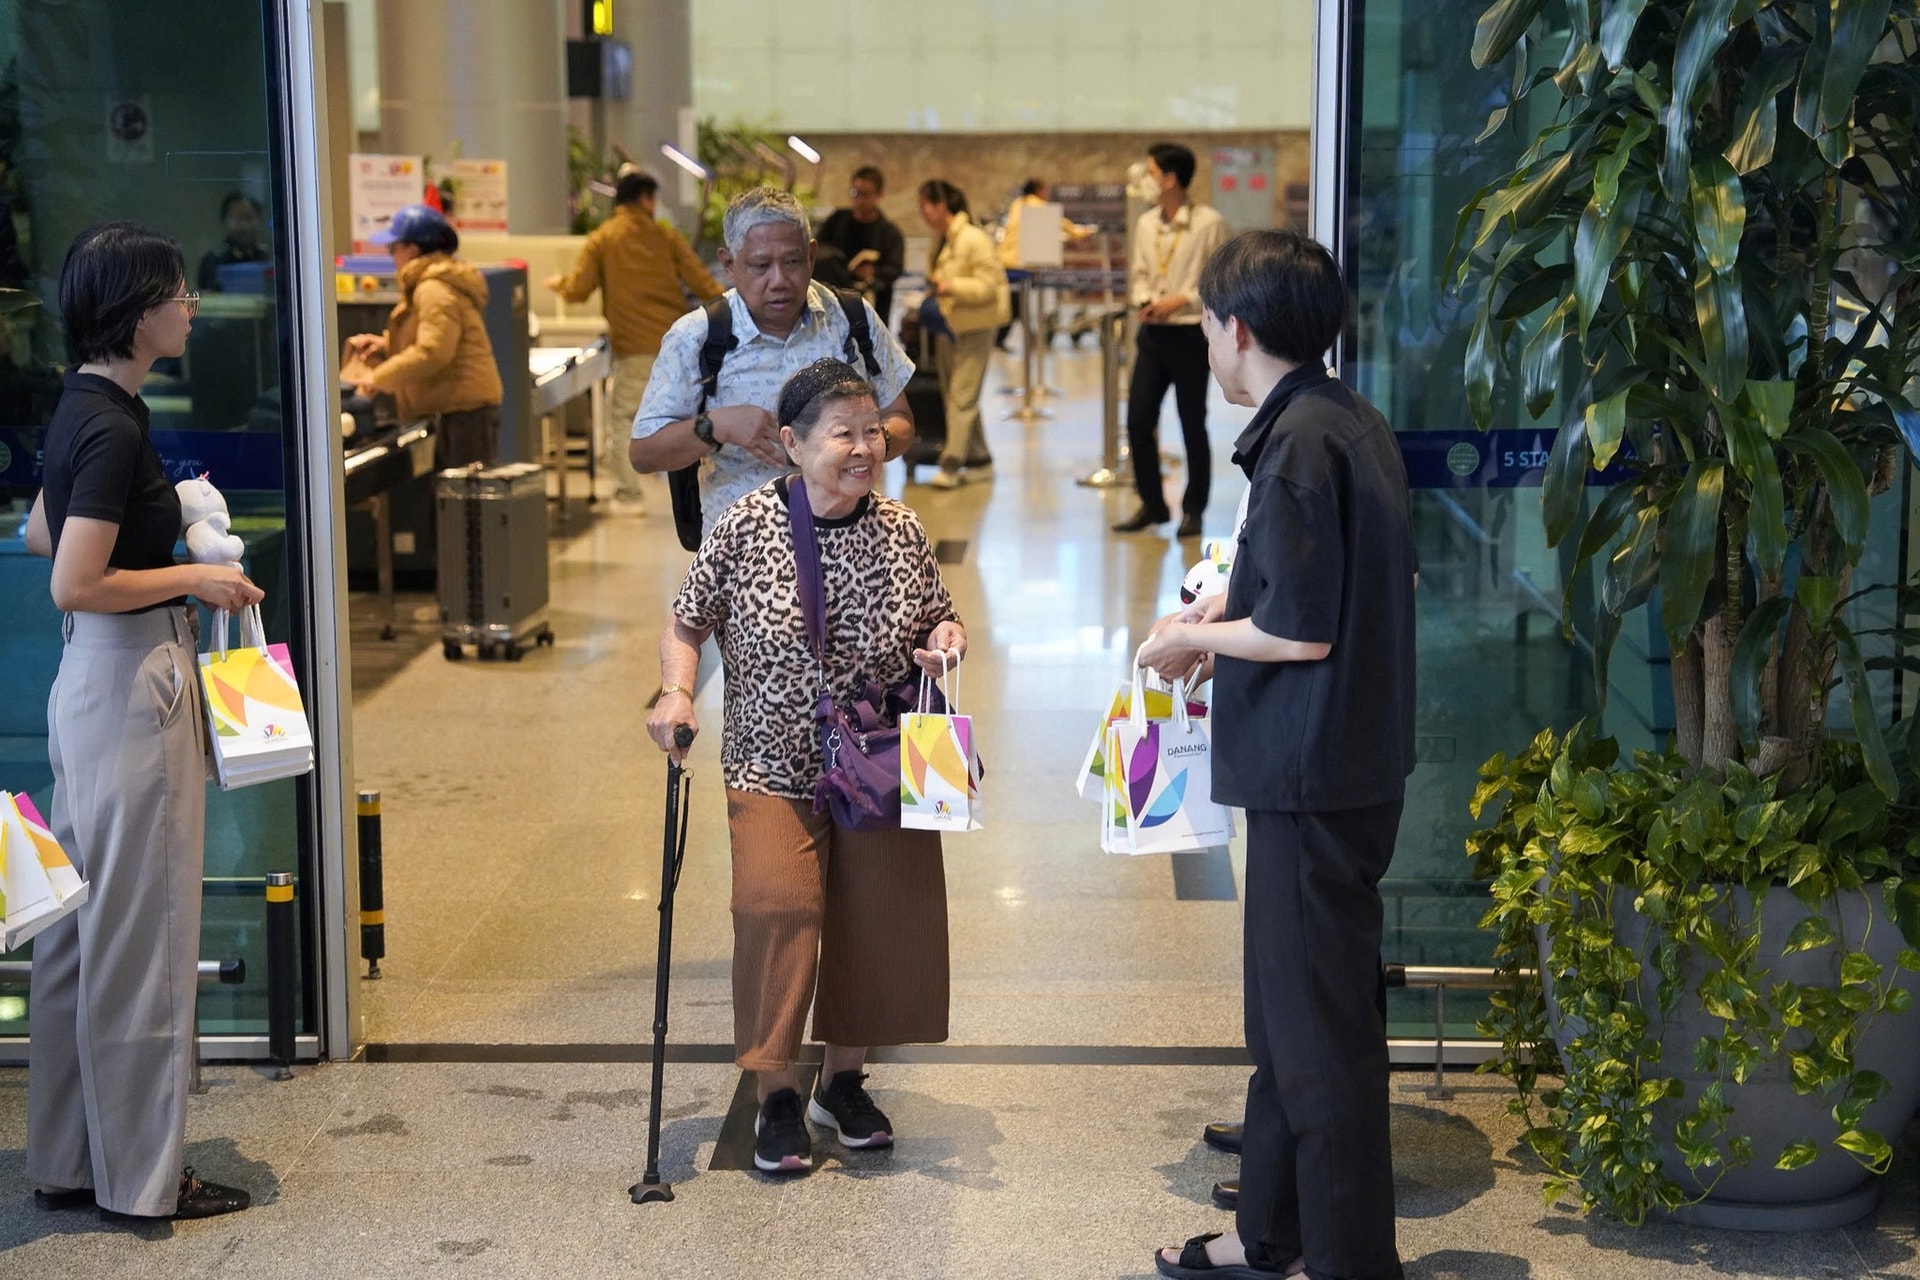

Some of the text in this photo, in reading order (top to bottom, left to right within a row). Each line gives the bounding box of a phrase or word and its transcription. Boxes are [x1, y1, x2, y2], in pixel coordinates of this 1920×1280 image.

[1504, 451, 1550, 467] 5 STA
[173, 458, 204, 478] you
[1167, 743, 1208, 756] DANANG
